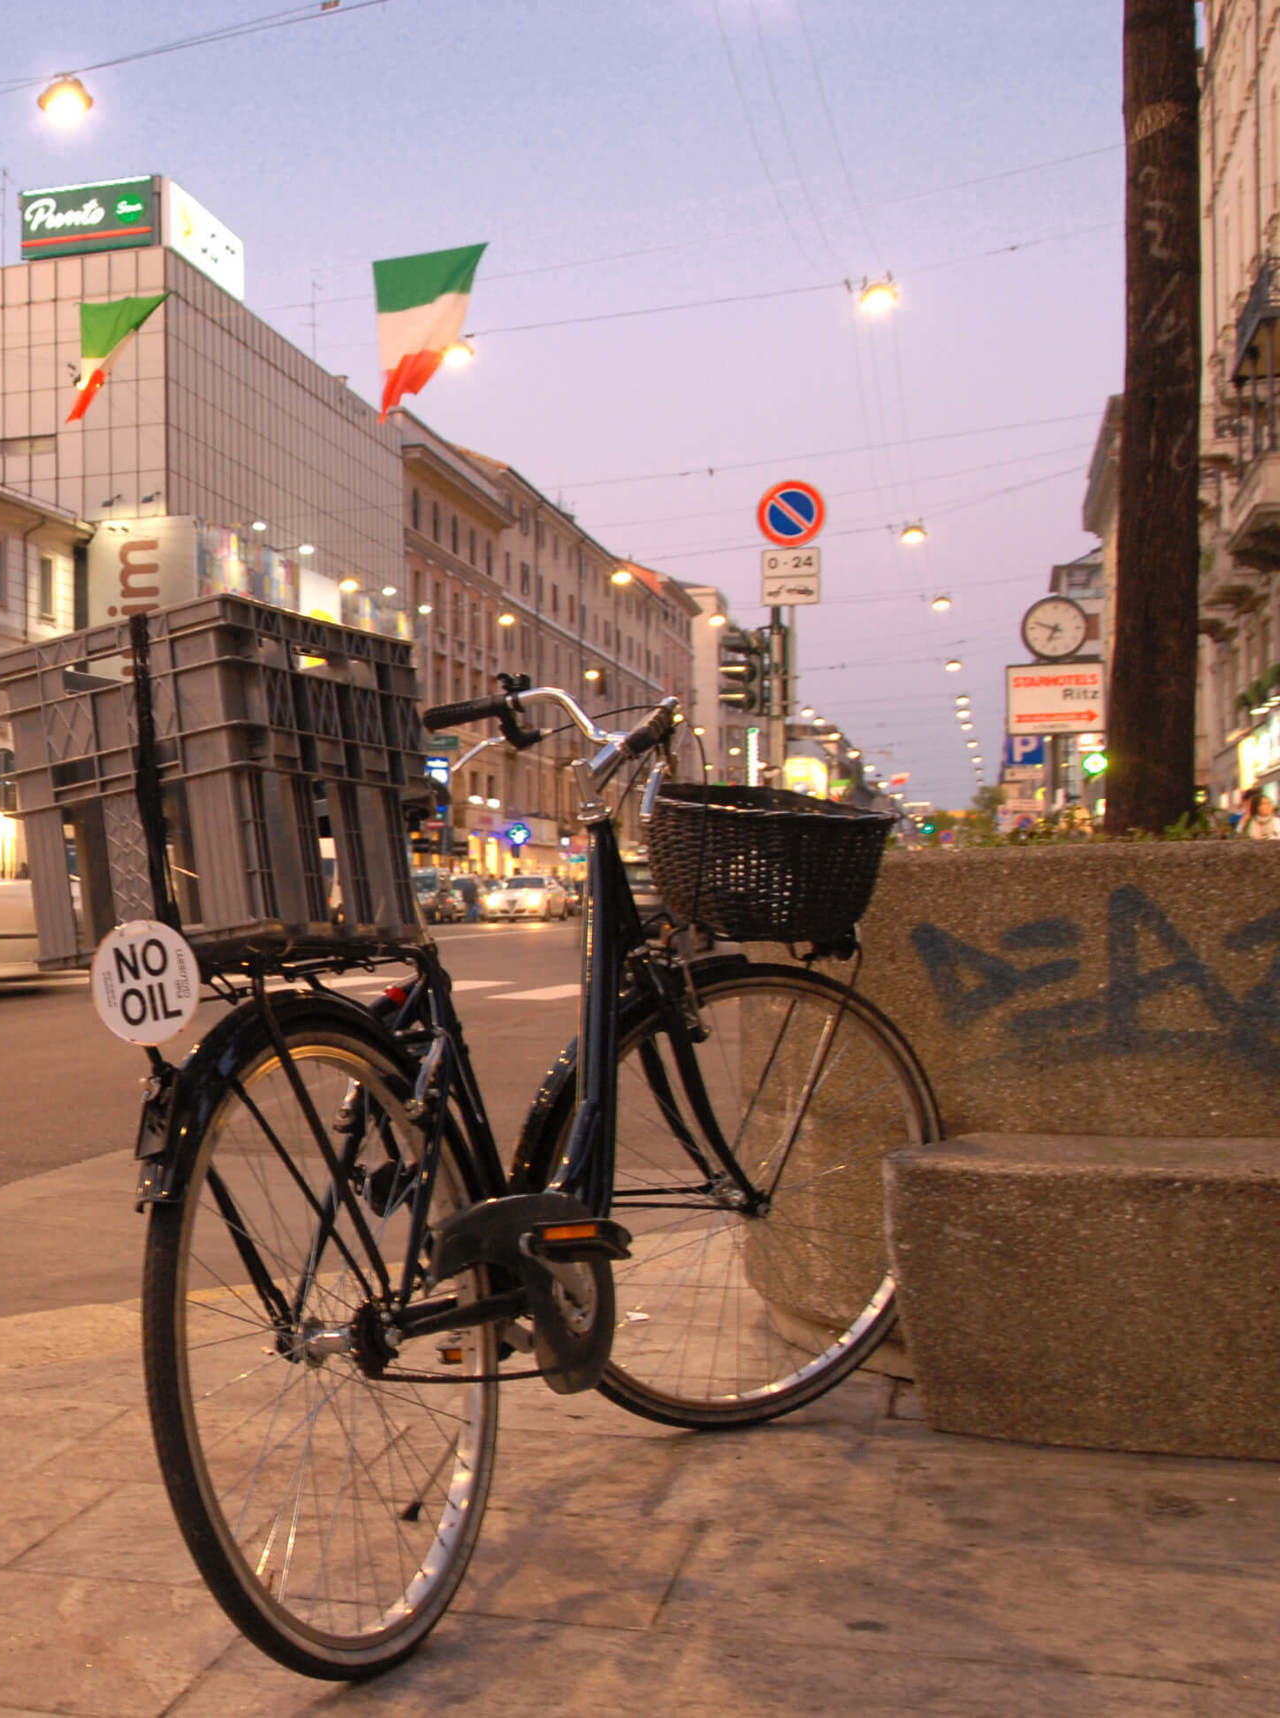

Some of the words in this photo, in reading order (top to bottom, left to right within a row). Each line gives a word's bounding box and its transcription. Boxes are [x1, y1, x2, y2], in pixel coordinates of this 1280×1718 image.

[791, 555, 814, 569] 24
[1013, 674, 1099, 688] STARHOTELS
[1062, 687, 1099, 701] Ritz
[1012, 735, 1039, 763] P
[112, 938, 167, 984] NO
[121, 982, 183, 1026] OIL
